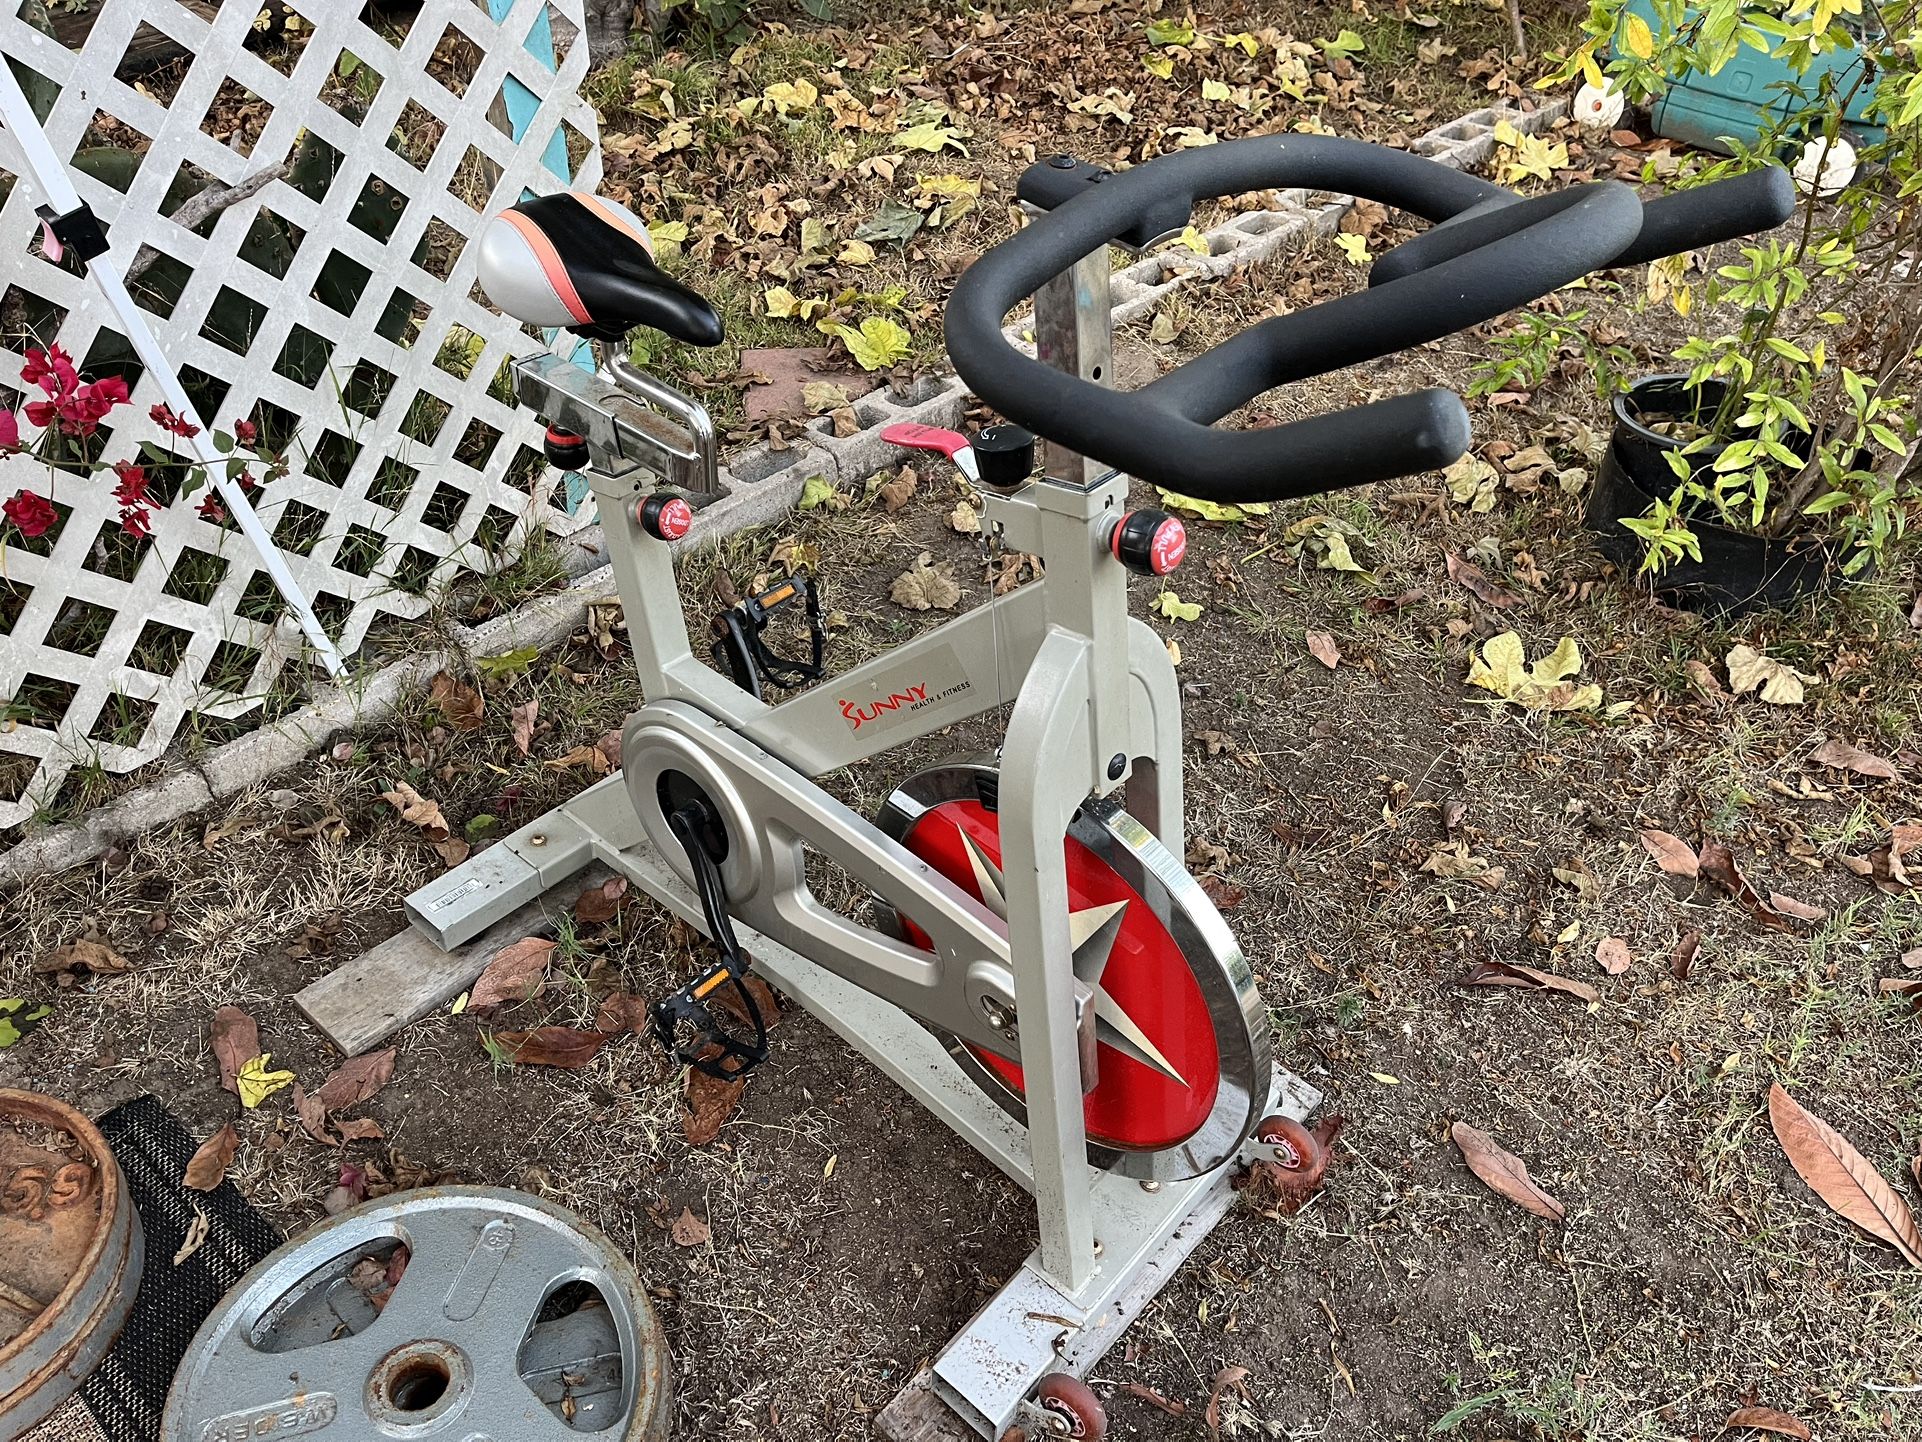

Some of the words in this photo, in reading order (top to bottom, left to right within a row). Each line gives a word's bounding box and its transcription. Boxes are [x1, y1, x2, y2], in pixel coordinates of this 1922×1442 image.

[839, 682, 926, 729] SUNNY
[910, 696, 935, 712] HEALTH
[943, 681, 971, 698] FITNESS
